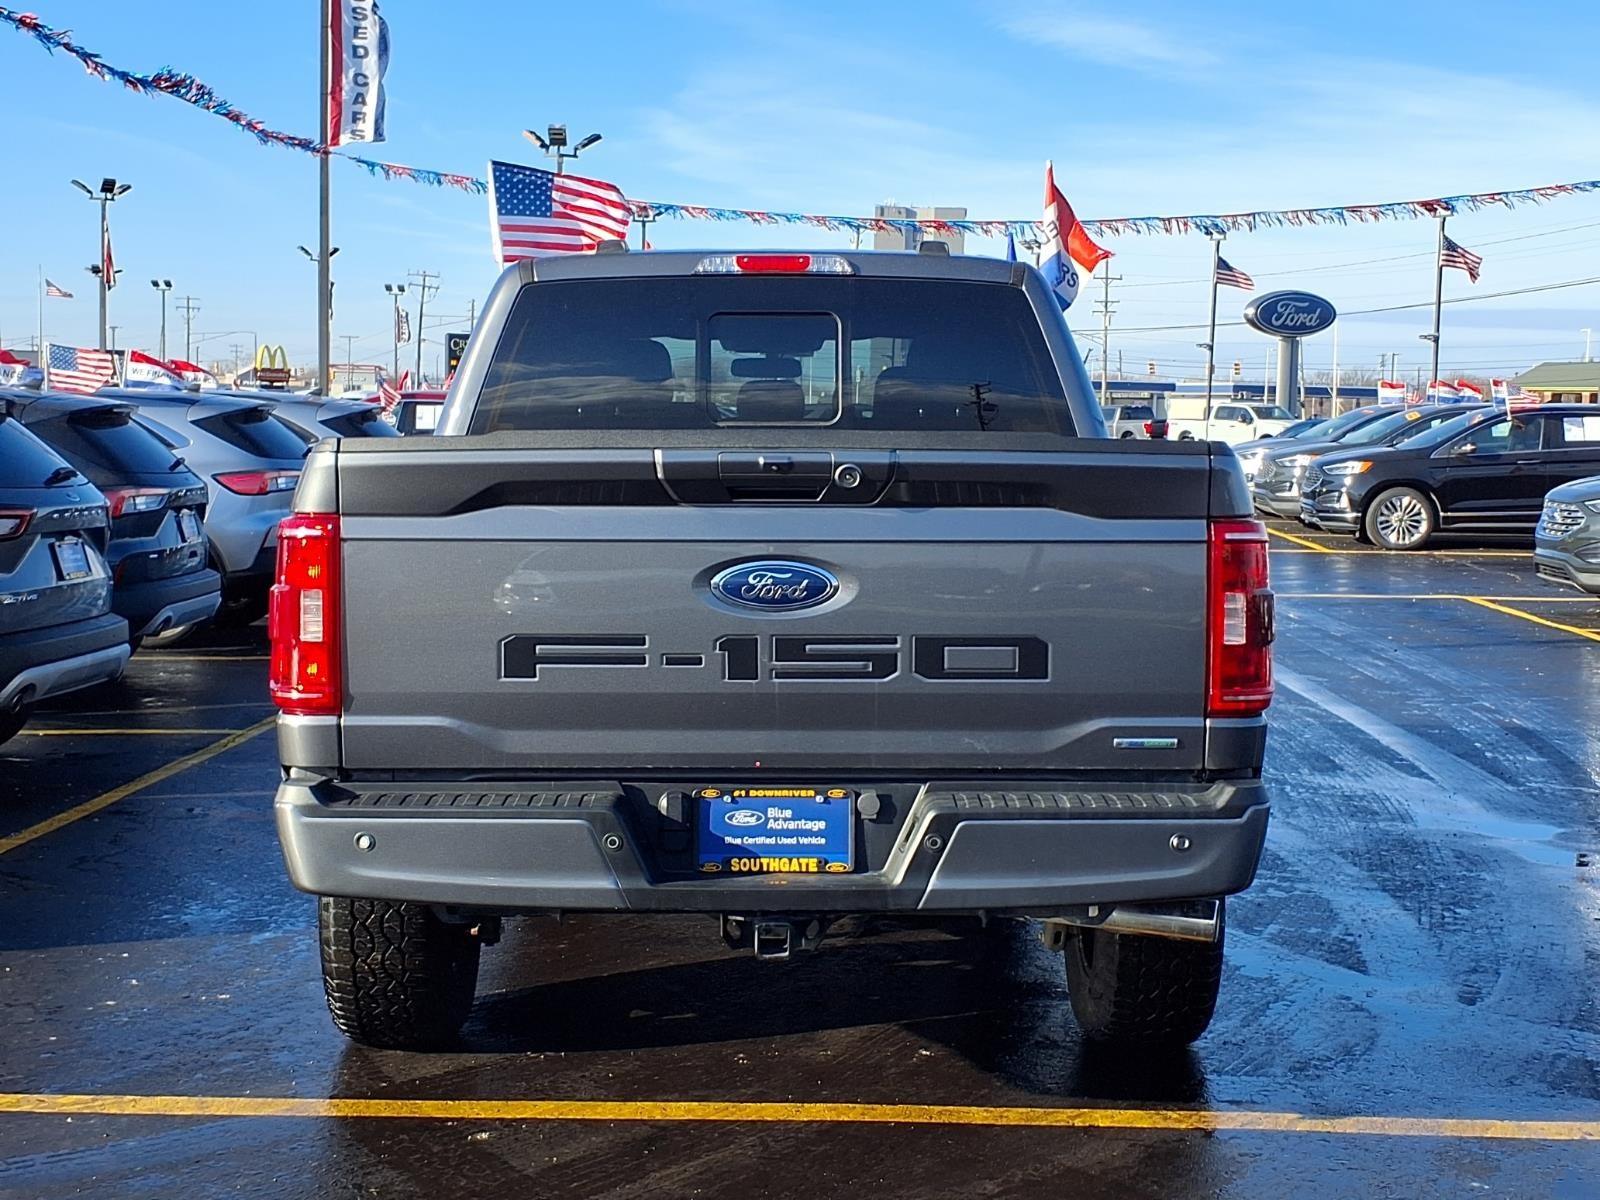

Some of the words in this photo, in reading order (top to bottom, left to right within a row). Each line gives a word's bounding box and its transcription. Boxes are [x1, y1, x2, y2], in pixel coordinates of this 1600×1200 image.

[351, 0, 369, 59] SED
[349, 73, 369, 140] CARS
[1271, 300, 1321, 326] Ford
[450, 338, 468, 350] CR
[741, 571, 809, 599] Ford
[499, 634, 1052, 683] F-150
[749, 789, 815, 797] DOWNRIVER
[732, 812, 758, 823] Ford
[767, 807, 792, 818] Blue
[767, 818, 826, 831] Advantage
[724, 836, 742, 844] Blue
[743, 836, 775, 844] Certified
[777, 836, 797, 844] Used
[799, 836, 826, 844] Vehicle
[730, 858, 818, 872] SOUTHGATE
